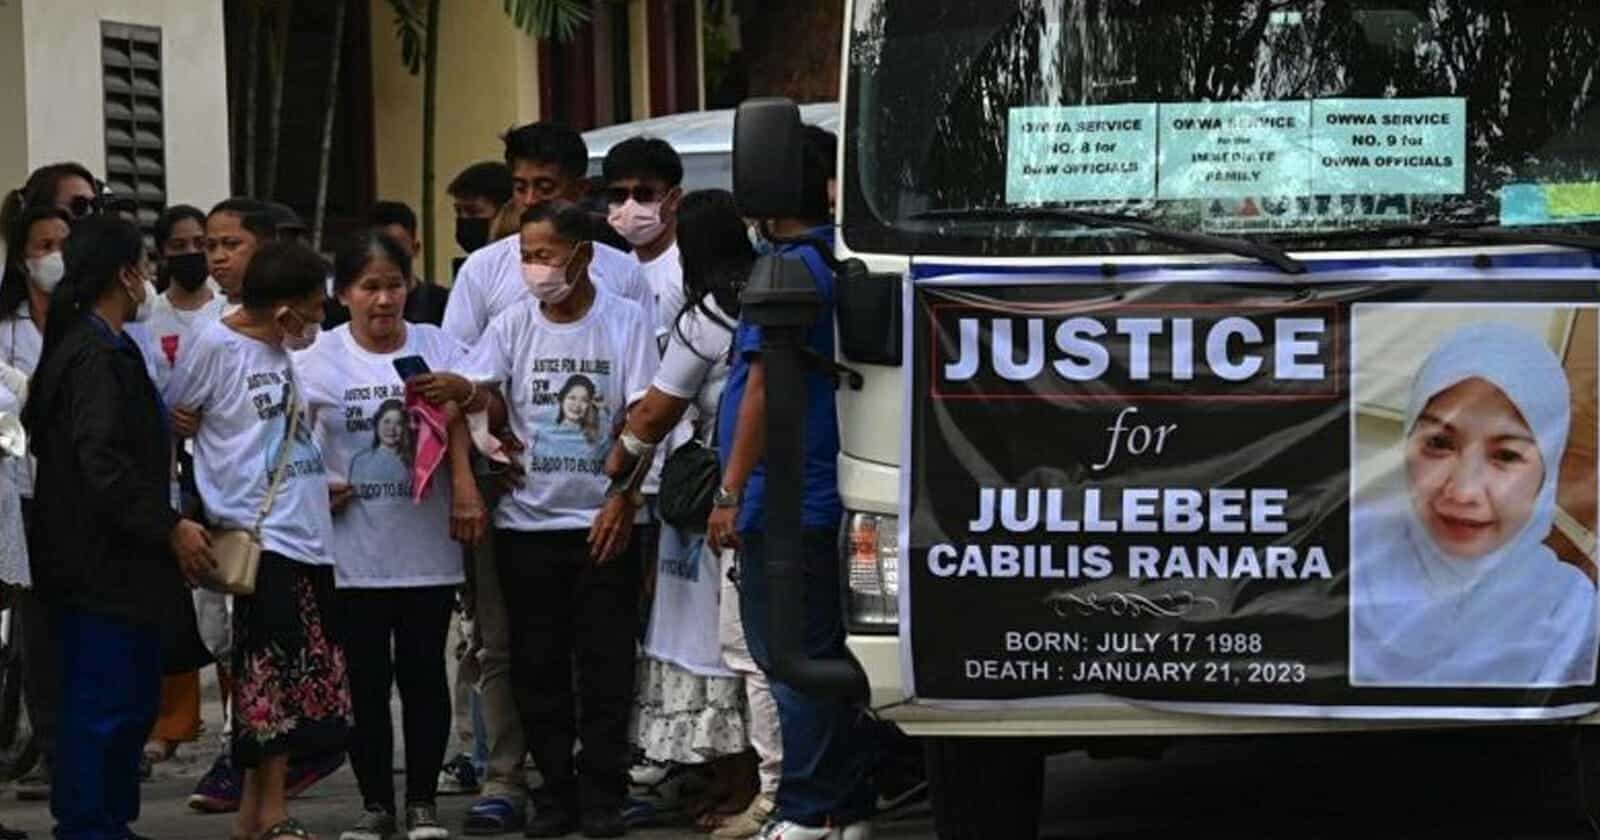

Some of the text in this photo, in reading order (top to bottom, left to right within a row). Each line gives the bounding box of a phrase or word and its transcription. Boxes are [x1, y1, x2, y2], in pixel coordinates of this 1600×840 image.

[1021, 118, 1143, 133] OWA SERVICE
[1172, 116, 1297, 131] OWWA VICE
[1326, 112, 1451, 126] OWWA SERVICE
[1081, 142, 1091, 153] 8
[1096, 141, 1117, 153] for
[1351, 134, 1424, 147] NO. 9 for
[1062, 161, 1139, 175] OFFICIALS
[1322, 155, 1454, 168] OWWA OFFICIALS
[944, 316, 1326, 381] JUSTICE
[1092, 406, 1177, 470] for
[968, 487, 1288, 533] JULLEBEE
[927, 543, 1332, 579] CABILIS RANARA
[1006, 631, 1262, 652] BORN: JULY 17 1988
[965, 660, 1306, 686] DEATH : JANUARY 21, 2023
